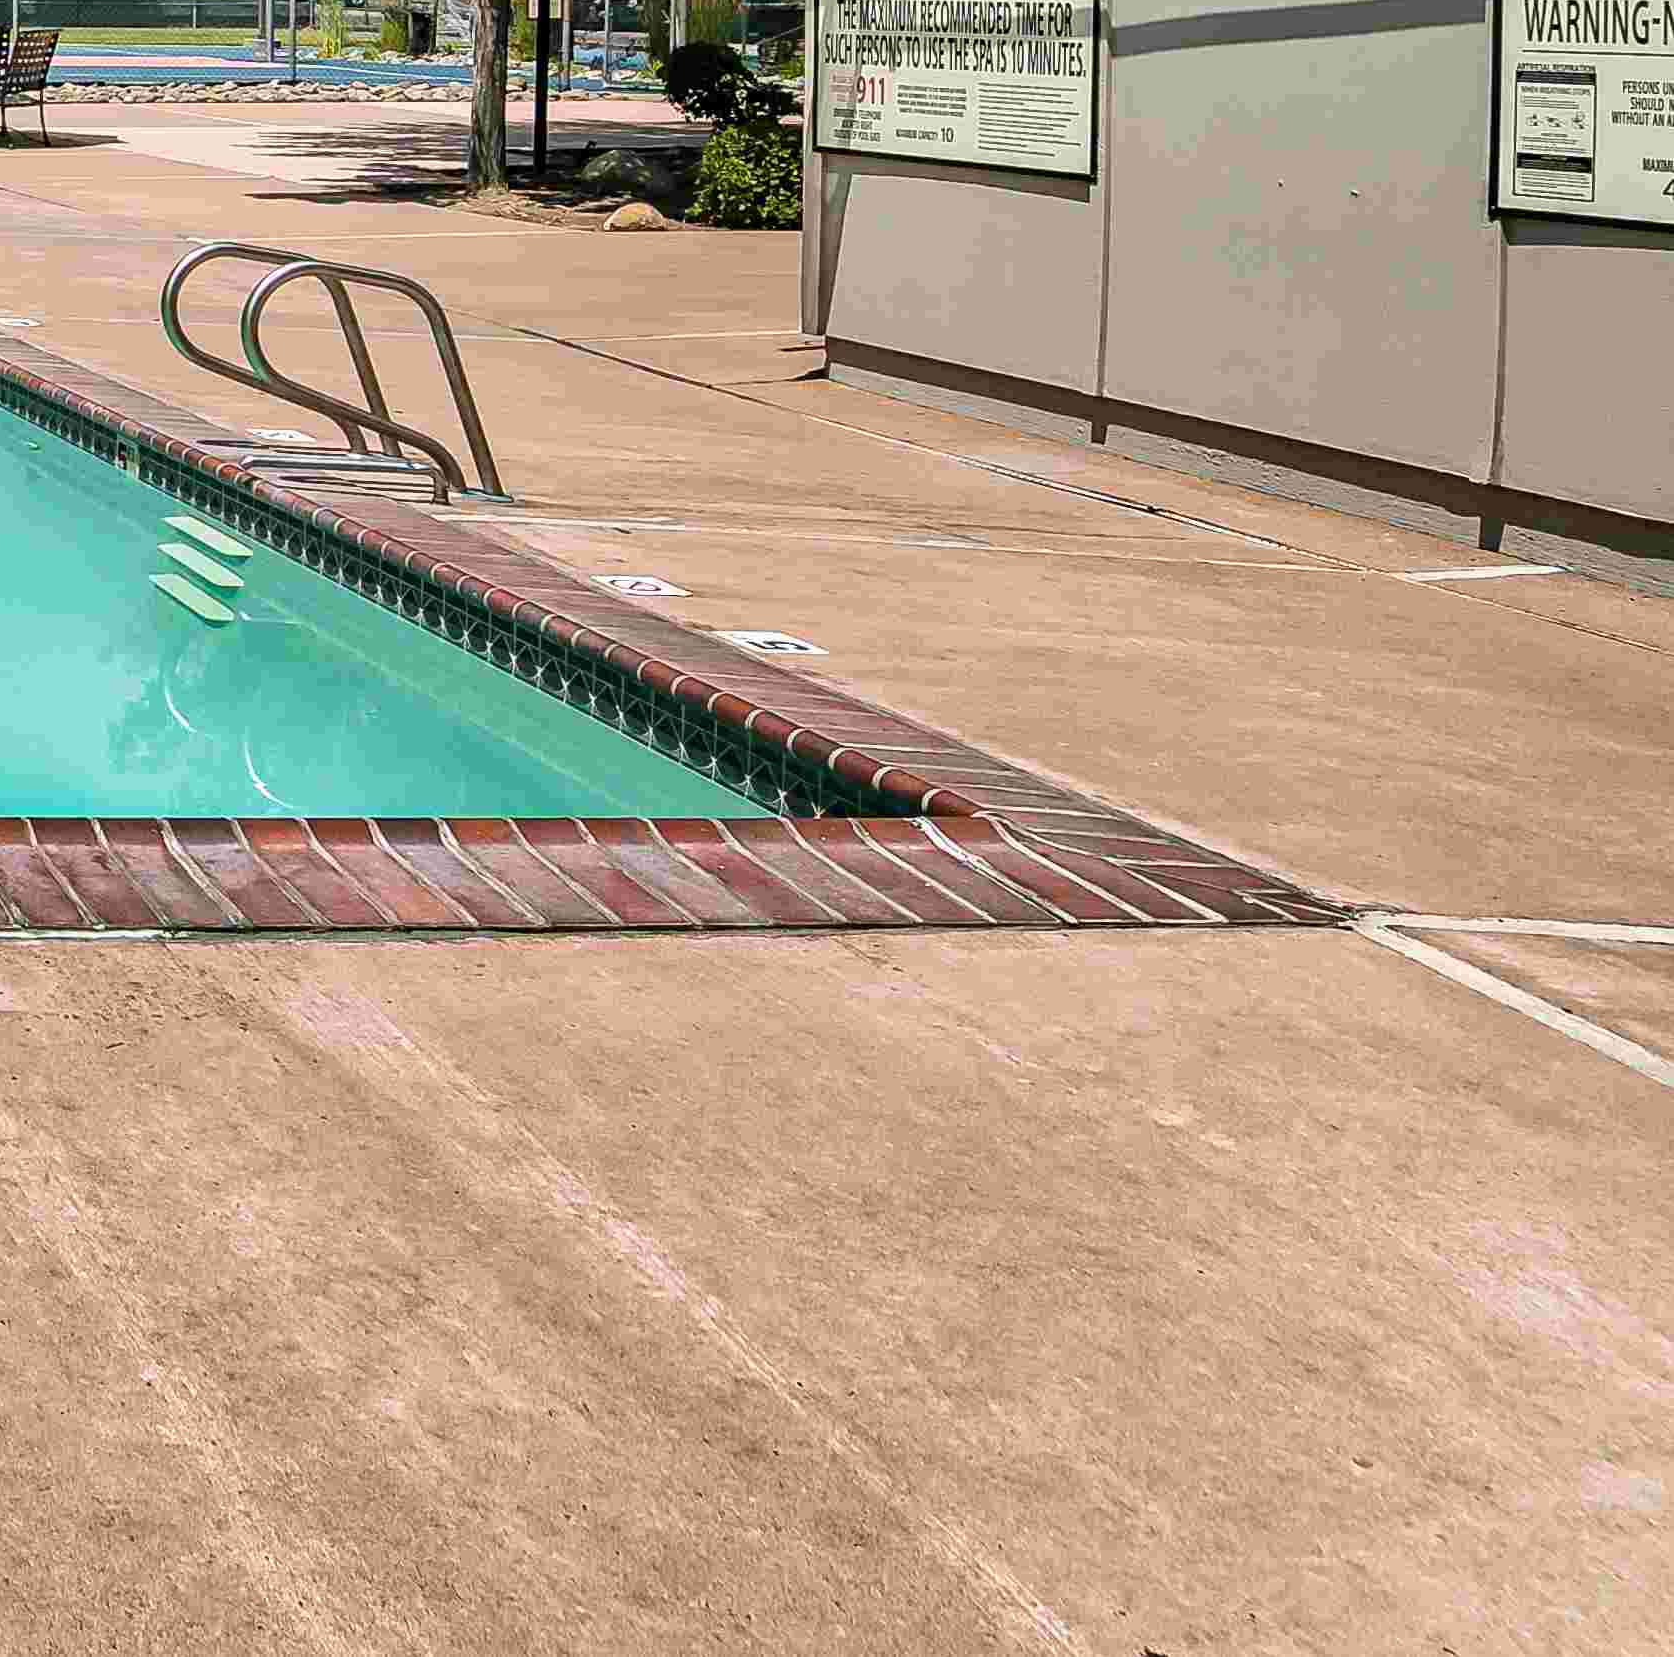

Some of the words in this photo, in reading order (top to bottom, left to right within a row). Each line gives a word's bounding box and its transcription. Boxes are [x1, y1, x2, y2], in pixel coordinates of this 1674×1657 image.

[860, 0, 917, 31] MAXIMUM
[920, 0, 1012, 35] RECOMMENDED
[1014, 2, 1044, 37] TIME
[1048, 2, 1074, 37] FOR
[825, 33, 853, 65] SUCH
[855, 34, 902, 68] PERSONS
[905, 36, 921, 69] TO
[924, 37, 945, 70] USE
[948, 38, 969, 71] THE
[972, 38, 994, 72] SPA
[996, 39, 1007, 73] IS
[1012, 40, 1024, 74] 10
[857, 75, 885, 105] 911
[1622, 80, 1660, 94] PERSONS
[1630, 97, 1664, 111] SHOULD
[1611, 110, 1650, 126] WITHOUT
[941, 127, 955, 143] 10
